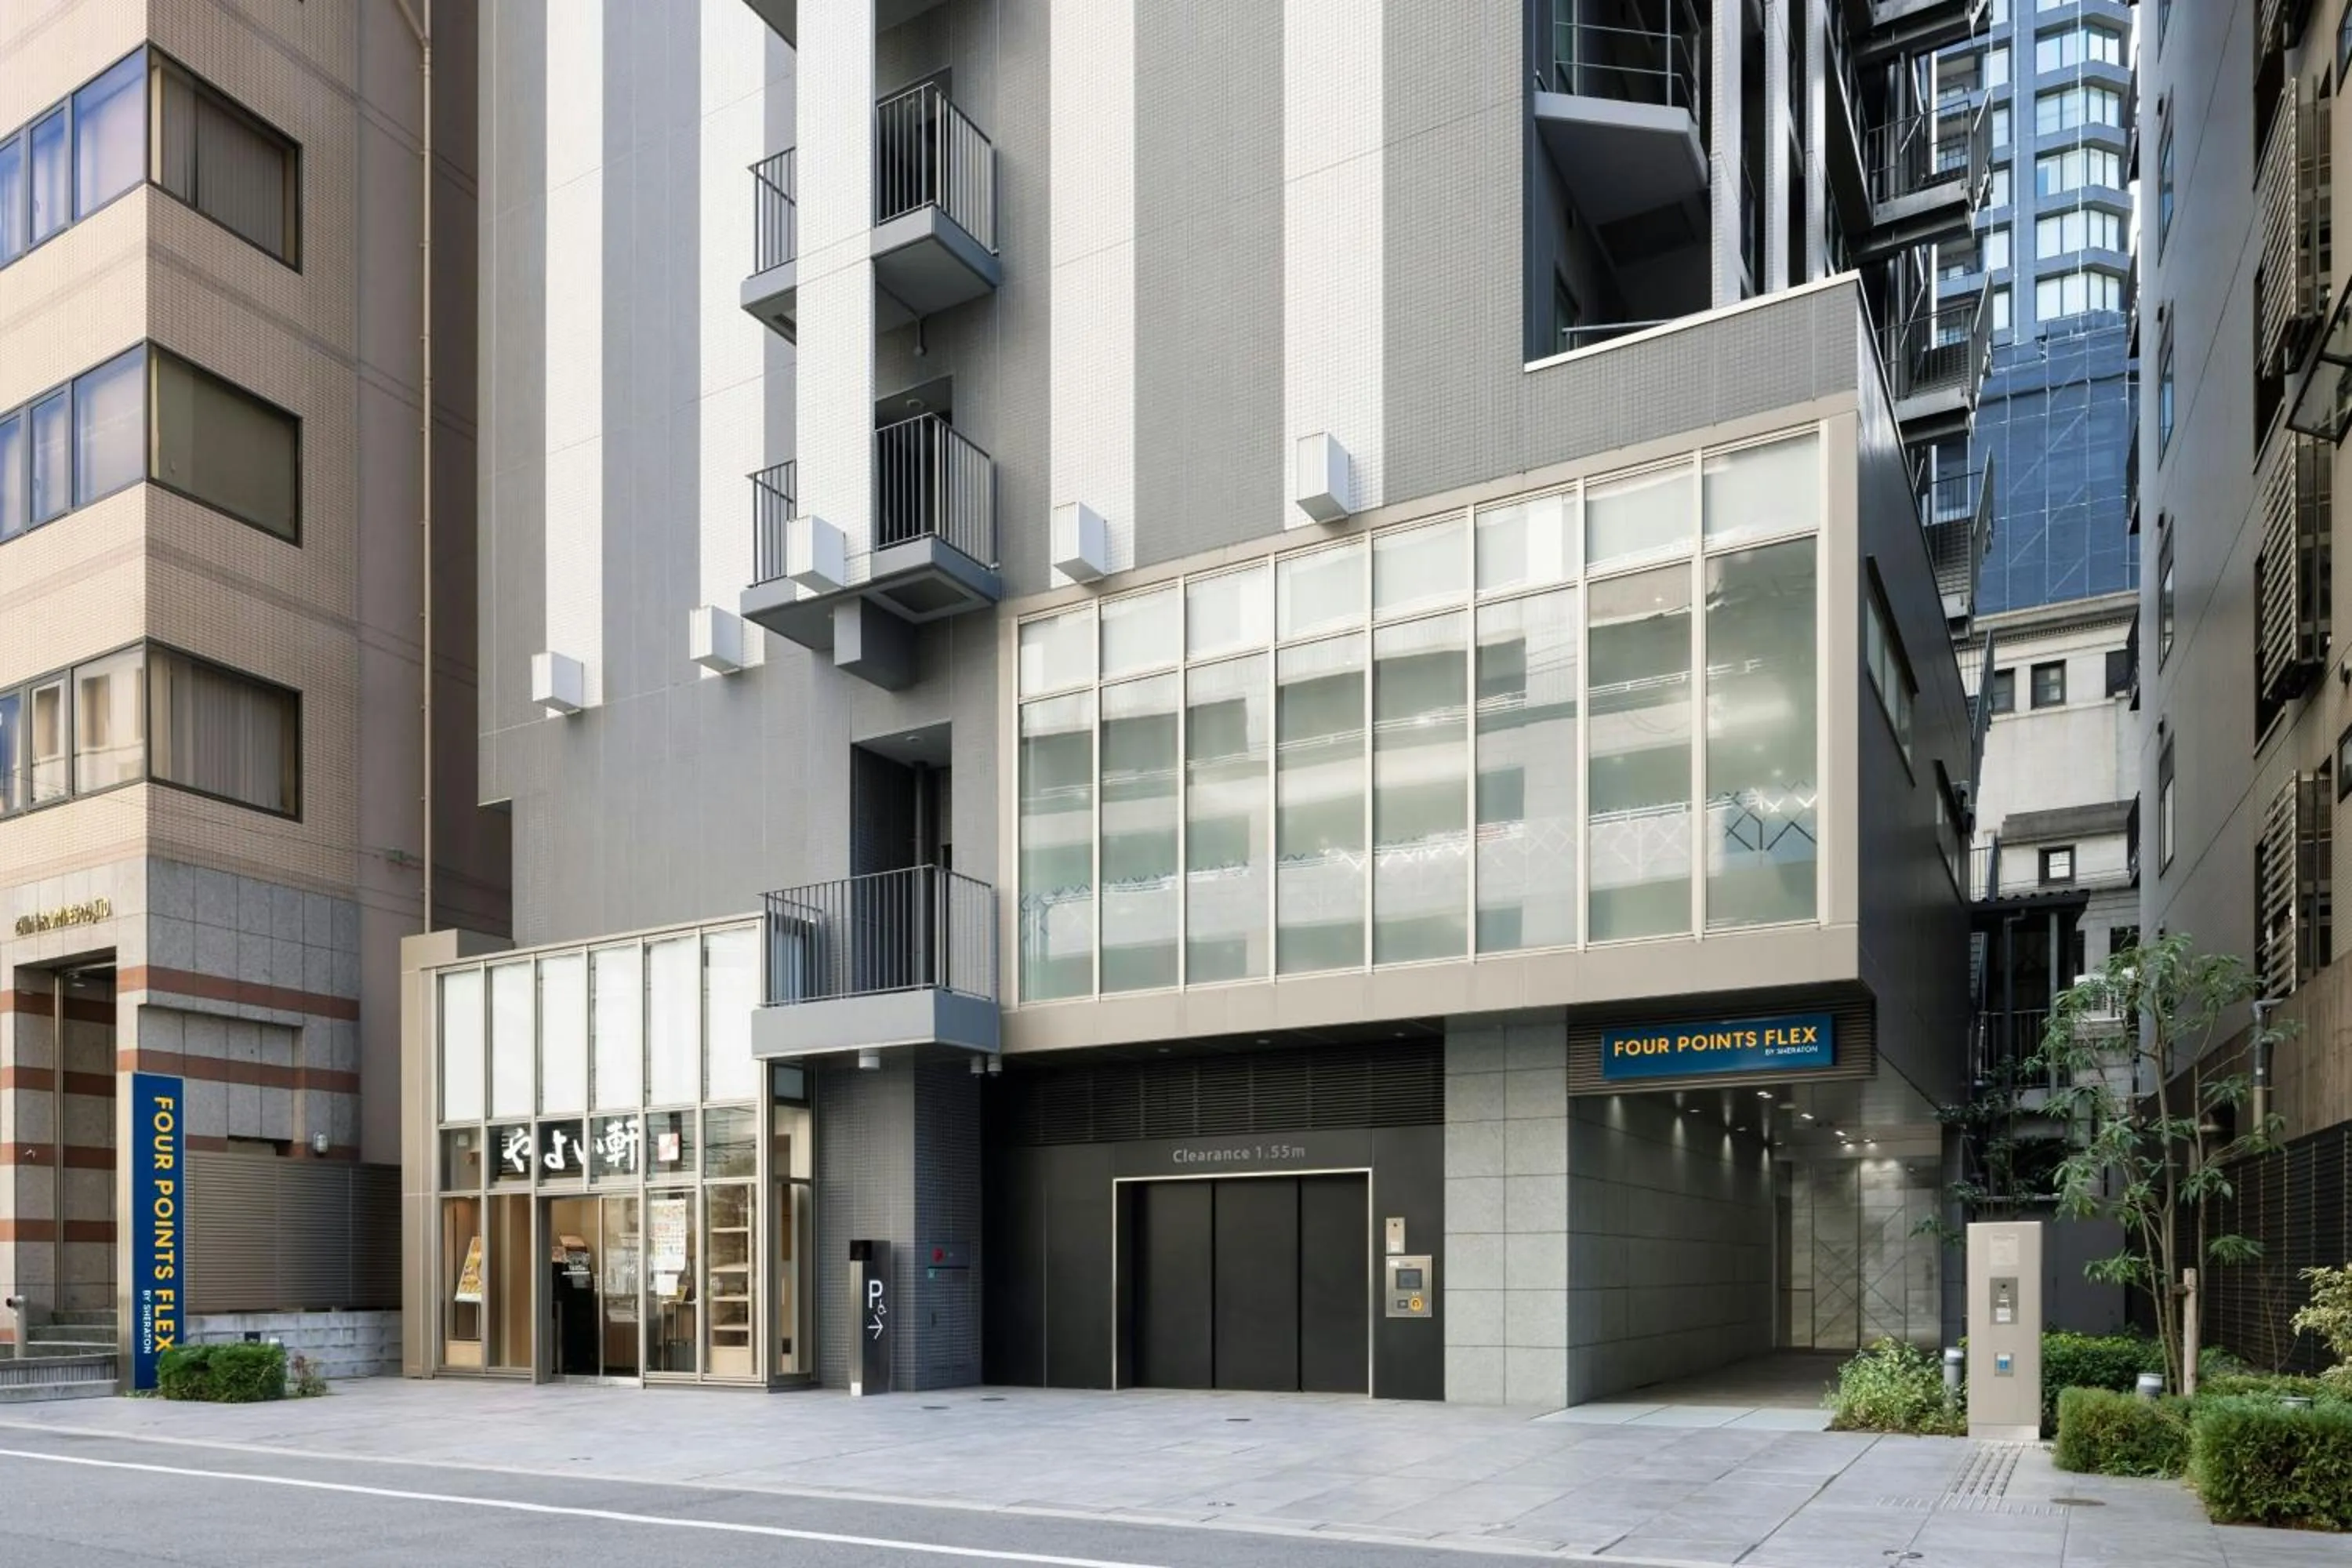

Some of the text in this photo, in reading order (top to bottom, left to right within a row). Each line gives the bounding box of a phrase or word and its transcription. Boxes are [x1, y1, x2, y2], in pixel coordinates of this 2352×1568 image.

[1613, 1026, 1817, 1057] FOUR POINTS FLEX
[503, 1120, 639, 1172] やよい軒
[1172, 1145, 1305, 1163] Clearance 1.55m
[154, 1097, 175, 1352] FOUR POINTS FLEX
[868, 1279, 883, 1308] P
[142, 1290, 151, 1354] BY SHERATON
